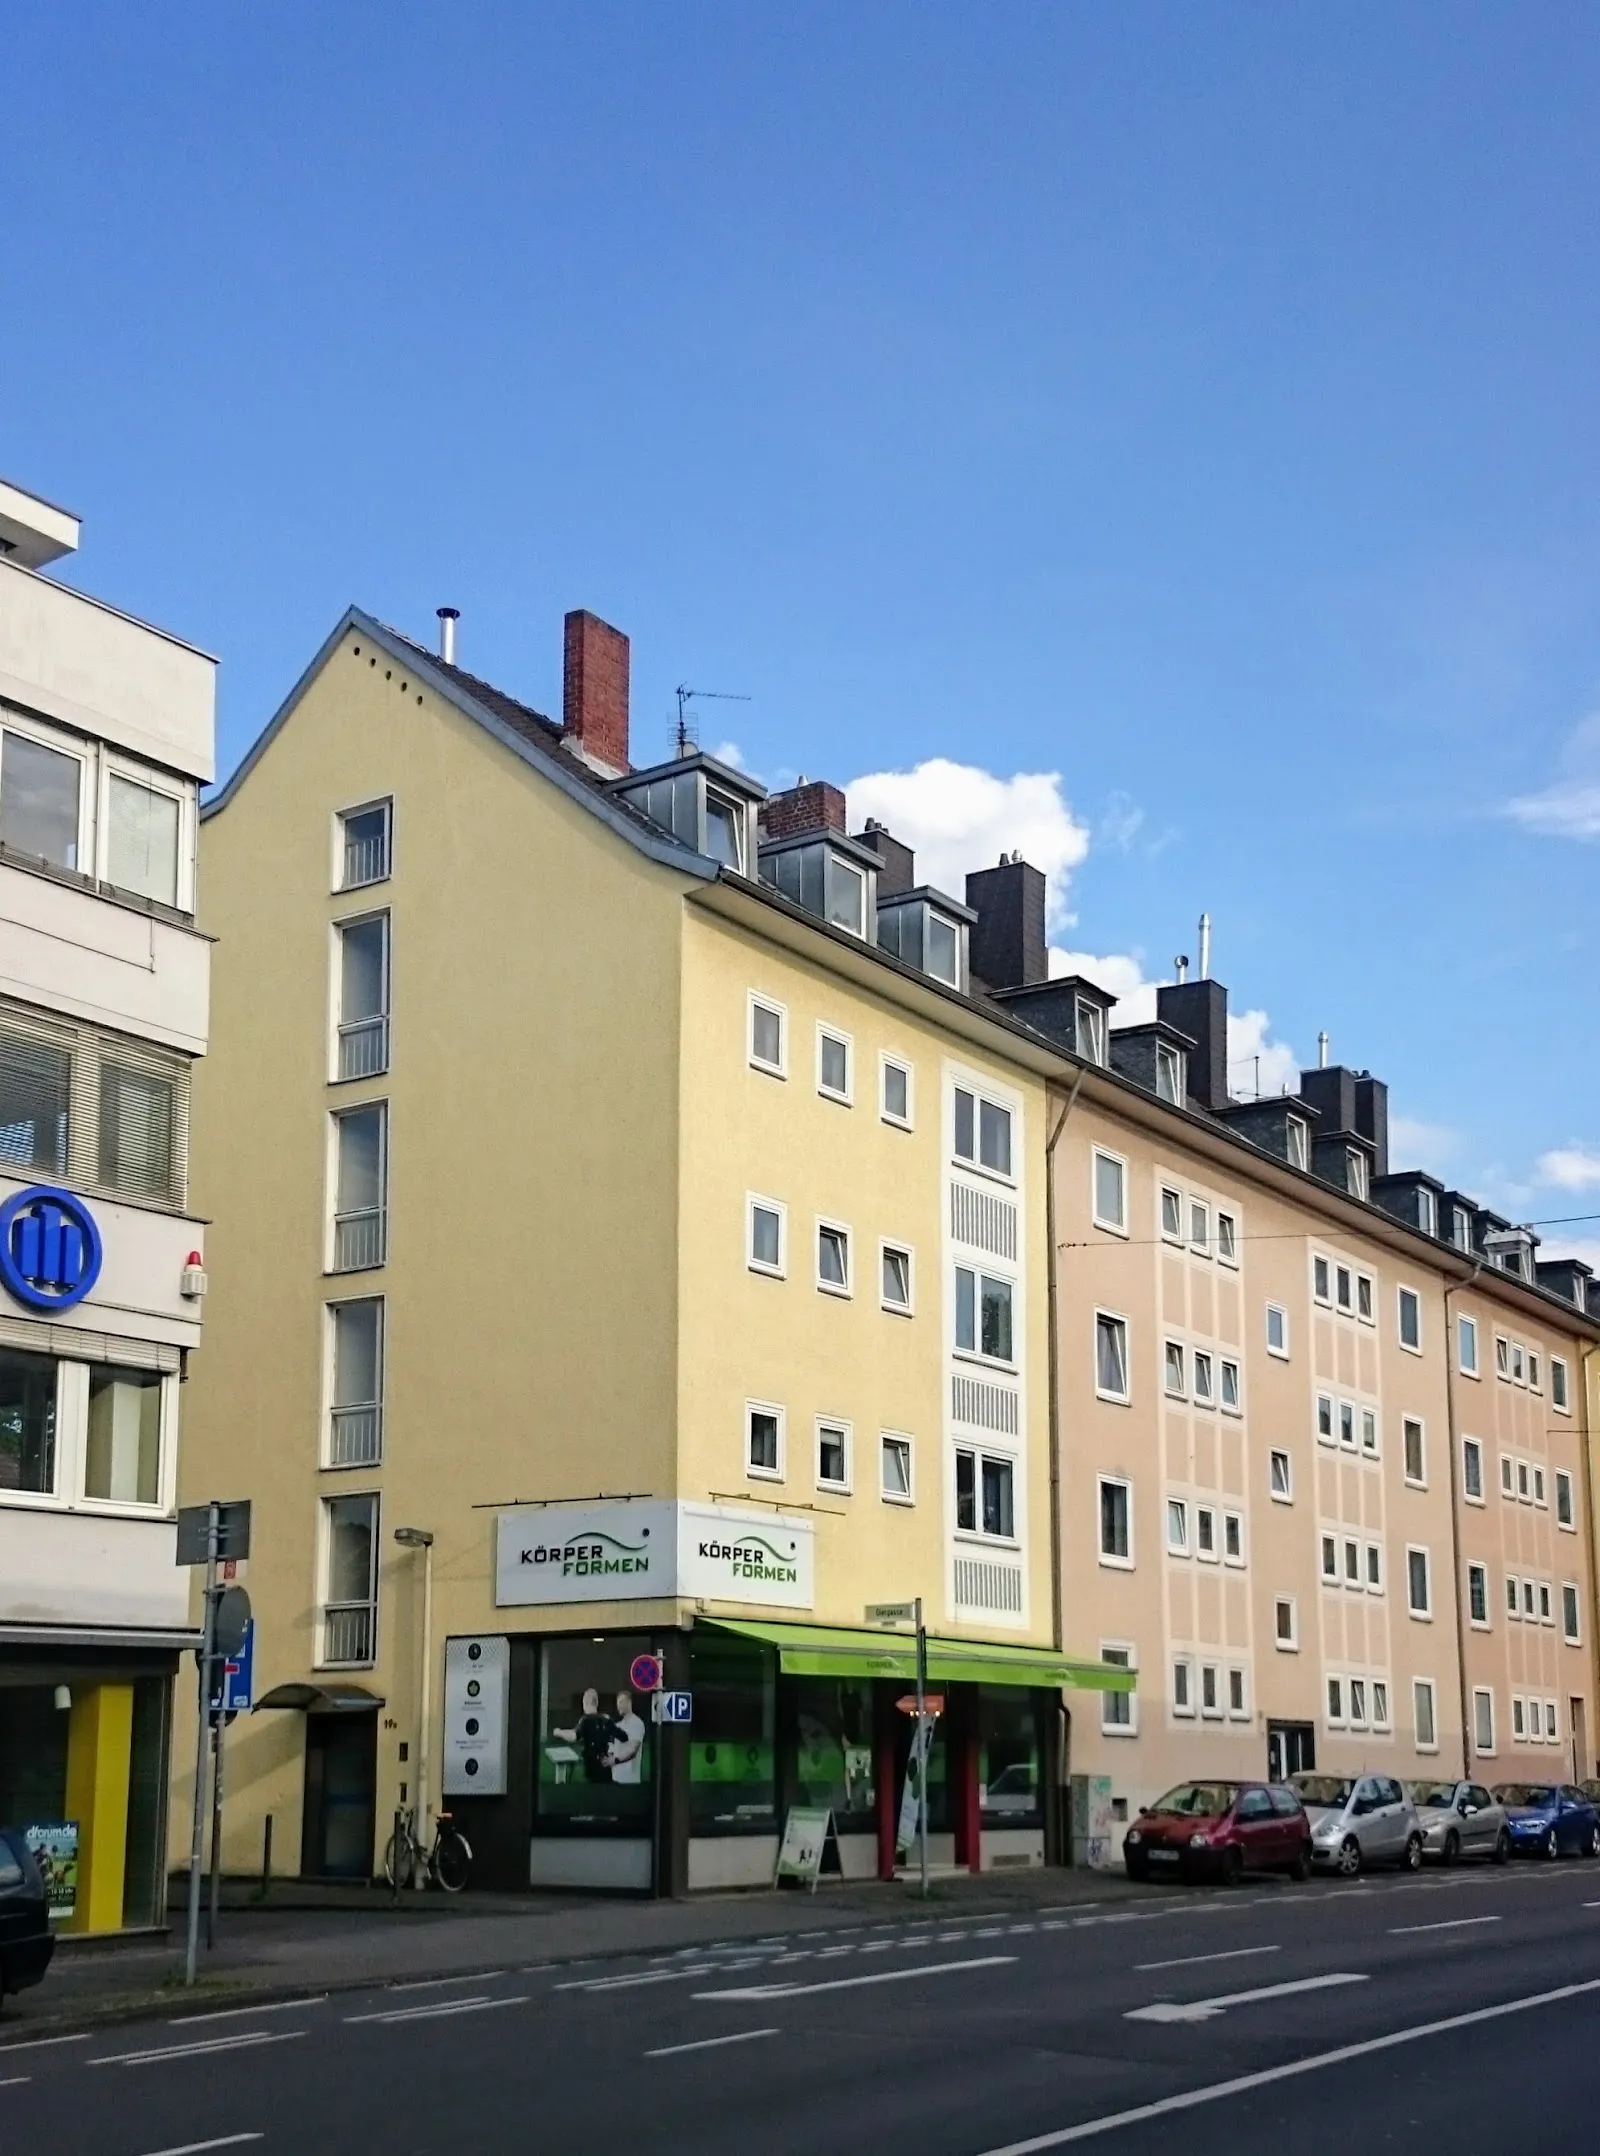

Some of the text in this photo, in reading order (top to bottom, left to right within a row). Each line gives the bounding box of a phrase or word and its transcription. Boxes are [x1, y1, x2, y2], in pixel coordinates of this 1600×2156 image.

[520, 1545, 603, 1564] KÖRPER
[699, 1540, 764, 1564] KÖRPER
[563, 1557, 649, 1576] FORMEN
[732, 1563, 797, 1582] FORMEN
[678, 1697, 688, 1716] P
